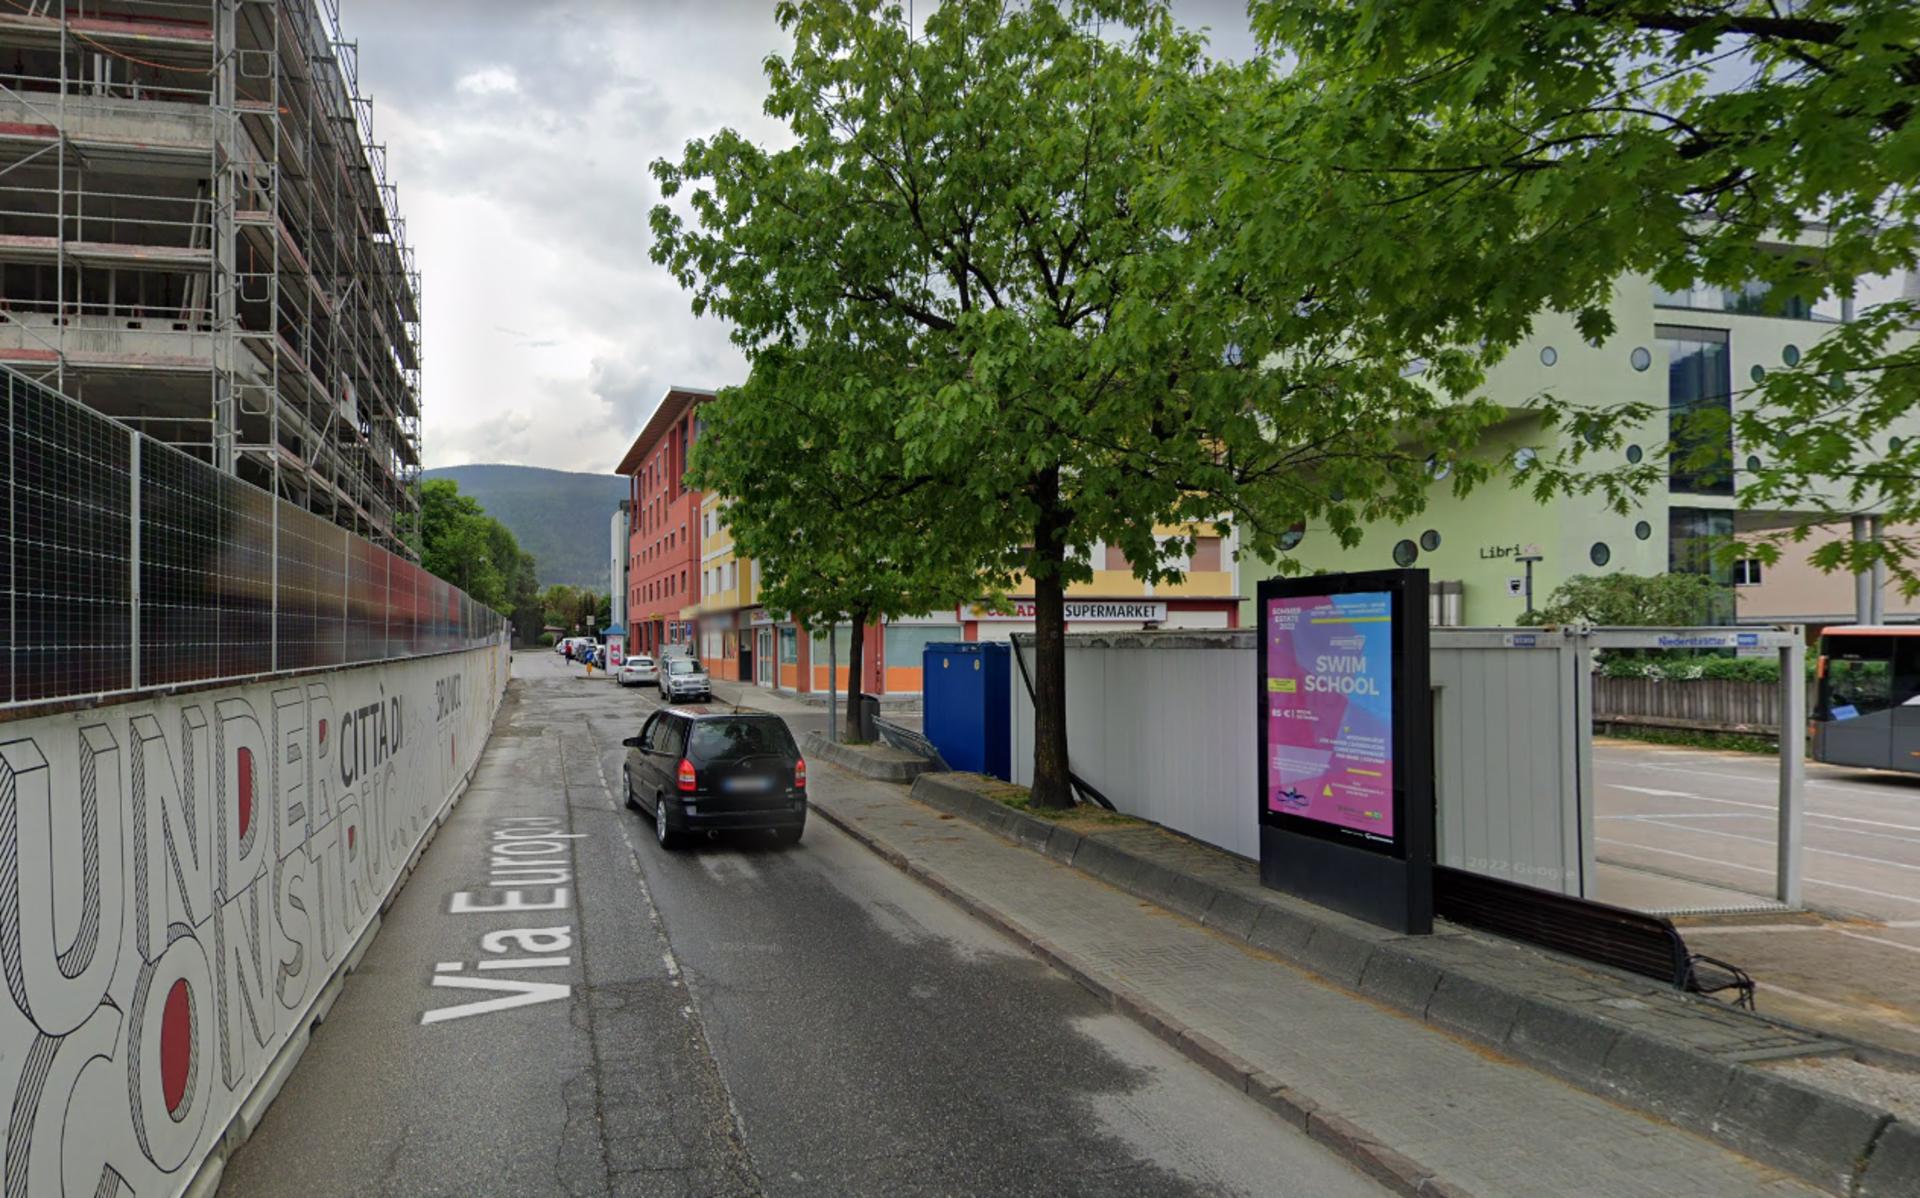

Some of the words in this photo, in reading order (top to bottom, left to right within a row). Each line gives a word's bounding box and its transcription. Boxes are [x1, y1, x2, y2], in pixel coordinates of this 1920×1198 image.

[1065, 604, 1157, 618] SUPERMARKET
[1315, 655, 1367, 675] SWIM
[1304, 674, 1380, 696] SCHOOL
[340, 681, 389, 788] CITTÀ
[0, 682, 337, 1037] UNDER
